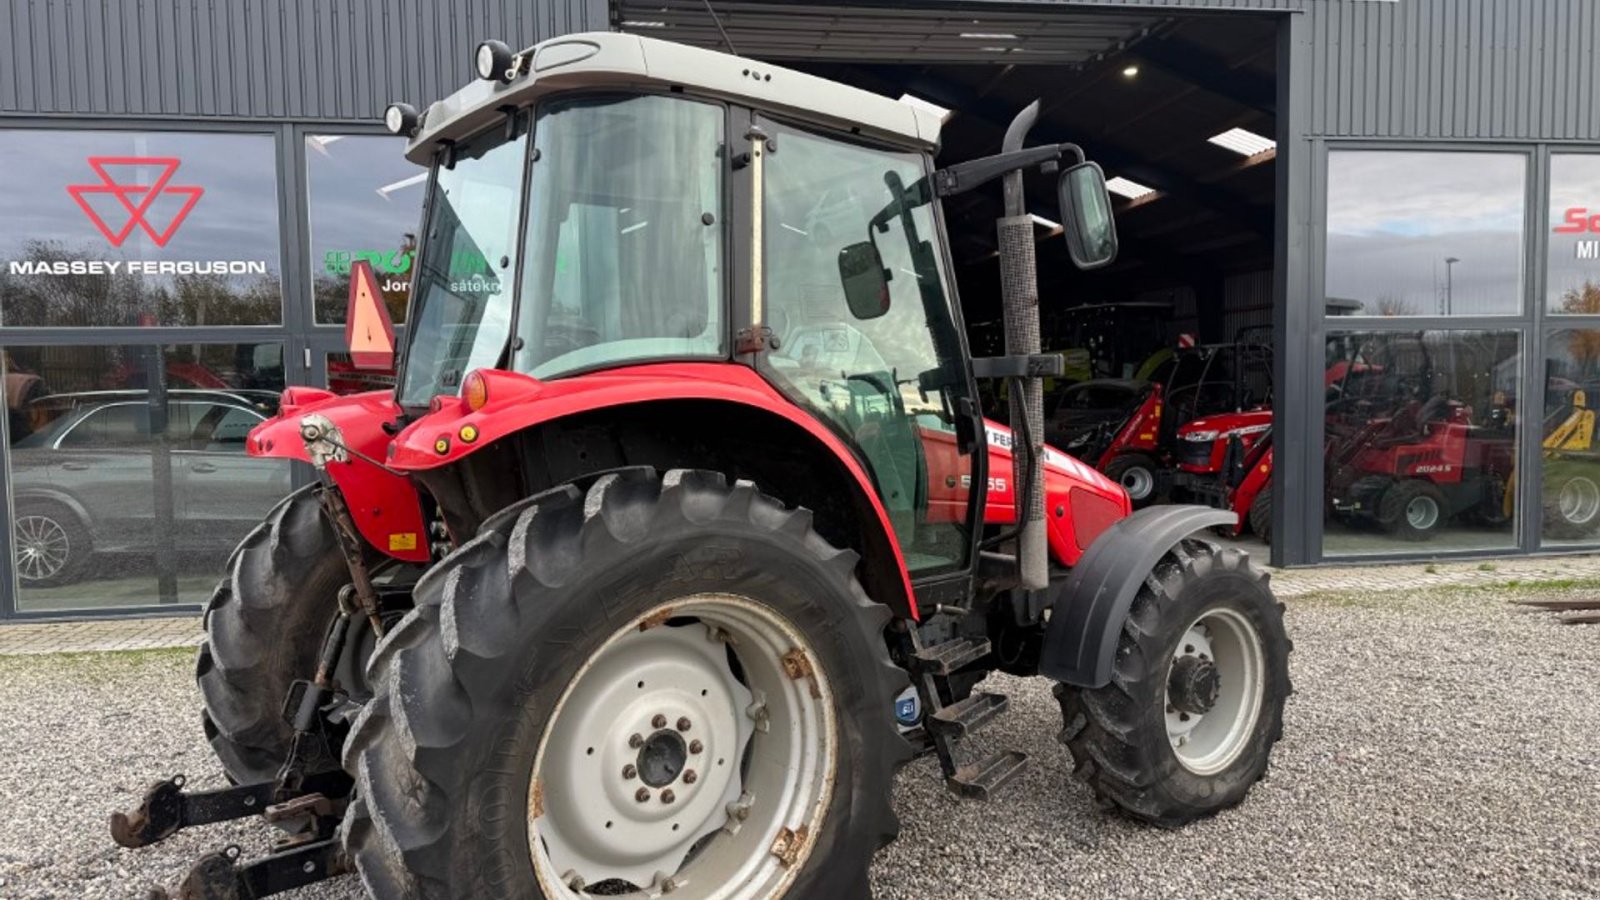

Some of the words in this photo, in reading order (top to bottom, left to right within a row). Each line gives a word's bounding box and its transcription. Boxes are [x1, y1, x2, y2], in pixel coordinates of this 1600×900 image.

[1577, 240, 1599, 259] MI
[10, 261, 121, 275] MASSEY
[127, 261, 267, 275] FERGUSON
